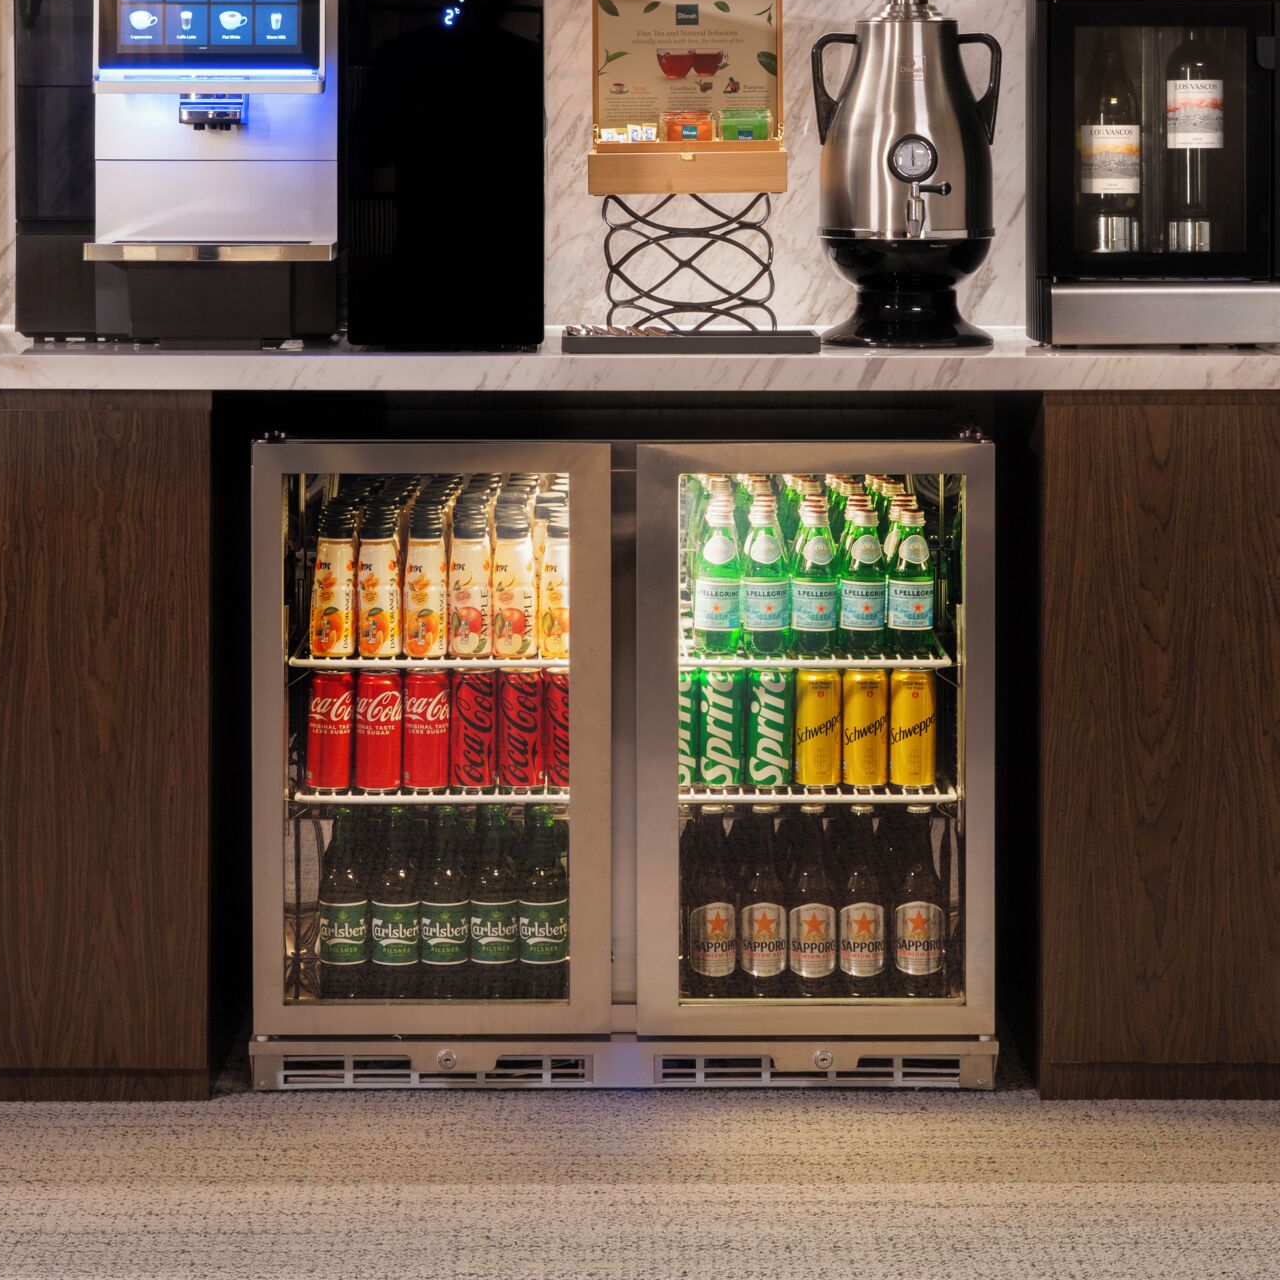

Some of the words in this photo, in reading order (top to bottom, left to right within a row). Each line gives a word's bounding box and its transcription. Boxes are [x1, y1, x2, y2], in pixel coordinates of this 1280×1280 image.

[681, 29, 706, 37] Natural
[1105, 128, 1134, 136] VASCOS
[480, 588, 488, 636] APPLE
[523, 590, 533, 639] APPLE
[700, 671, 740, 785] Sprite
[749, 671, 789, 786] Sprite
